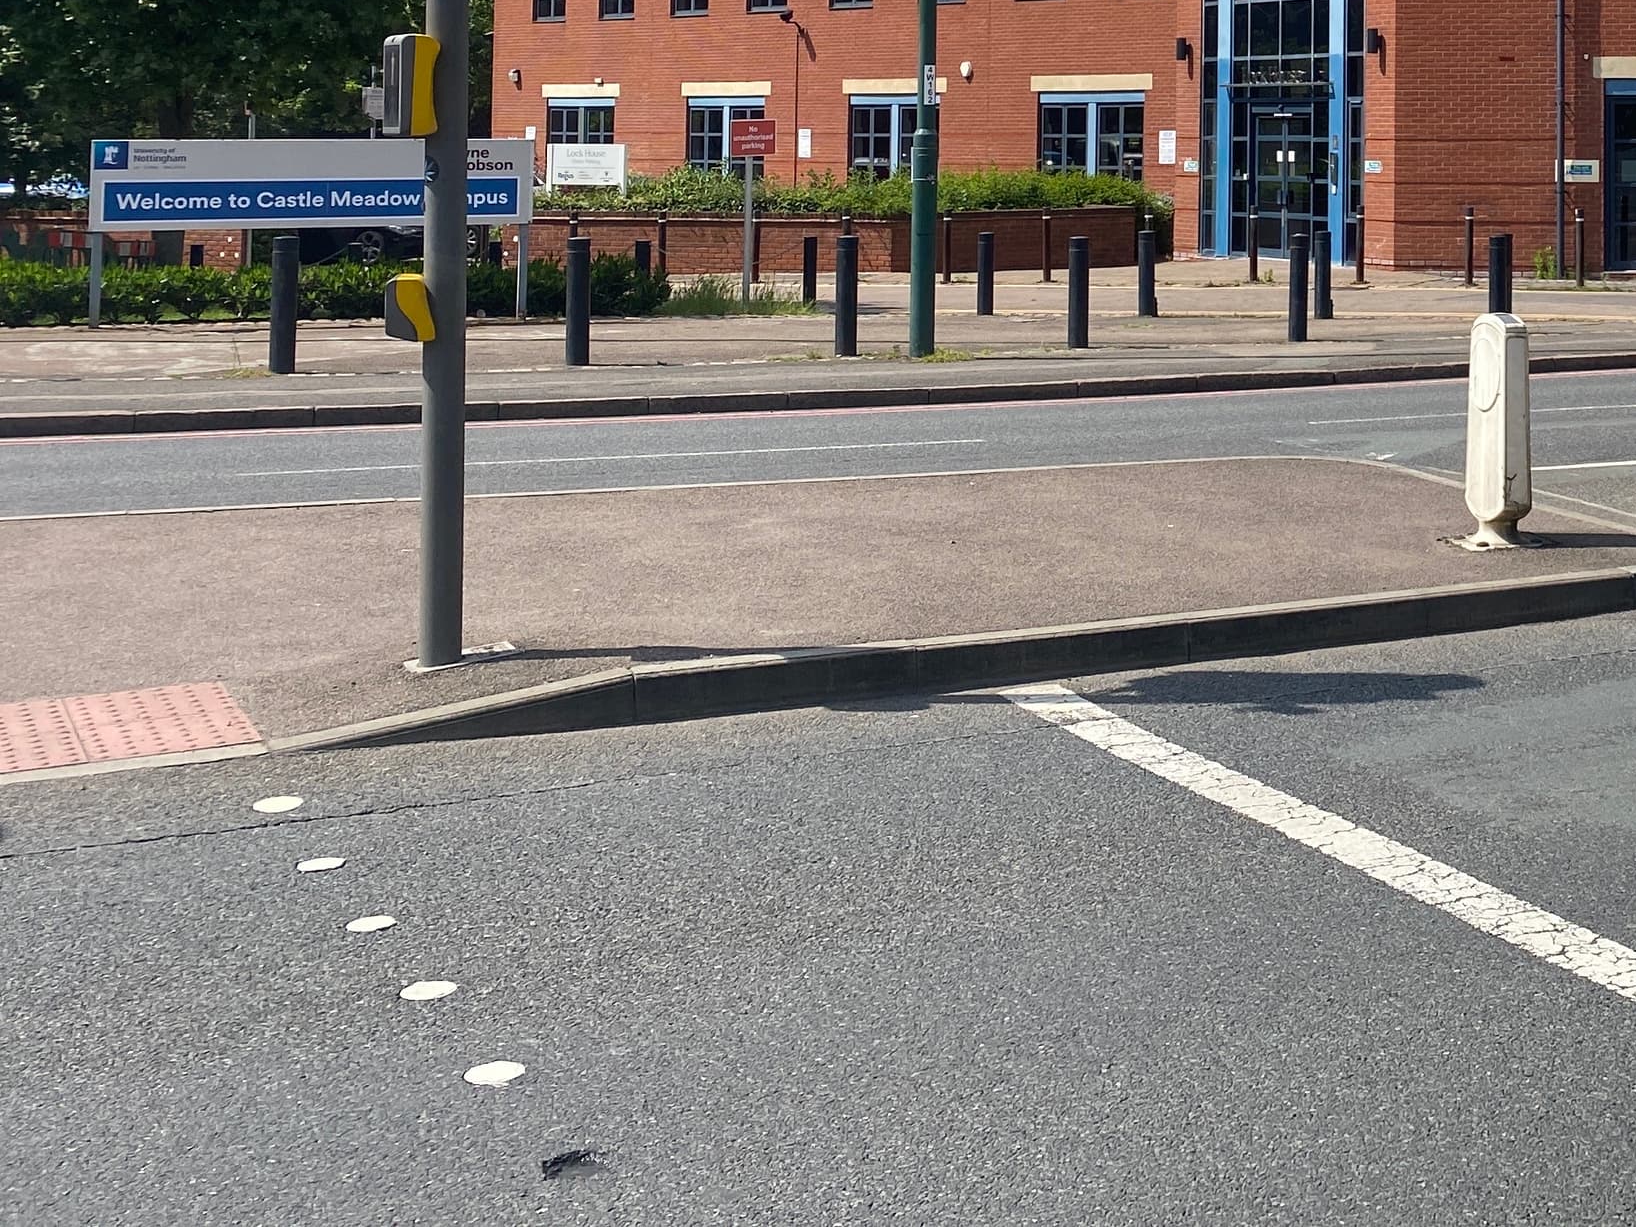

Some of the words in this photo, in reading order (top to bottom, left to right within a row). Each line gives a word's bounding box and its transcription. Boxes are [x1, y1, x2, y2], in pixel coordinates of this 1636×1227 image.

[748, 125, 759, 133] No
[741, 142, 765, 151] parking
[133, 154, 187, 164] Nottingham
[467, 158, 514, 171] obson
[116, 192, 222, 210] Welcome
[228, 193, 251, 209] to
[256, 191, 325, 209] Castle
[330, 190, 421, 208] Meadow
[466, 191, 509, 209] pus
